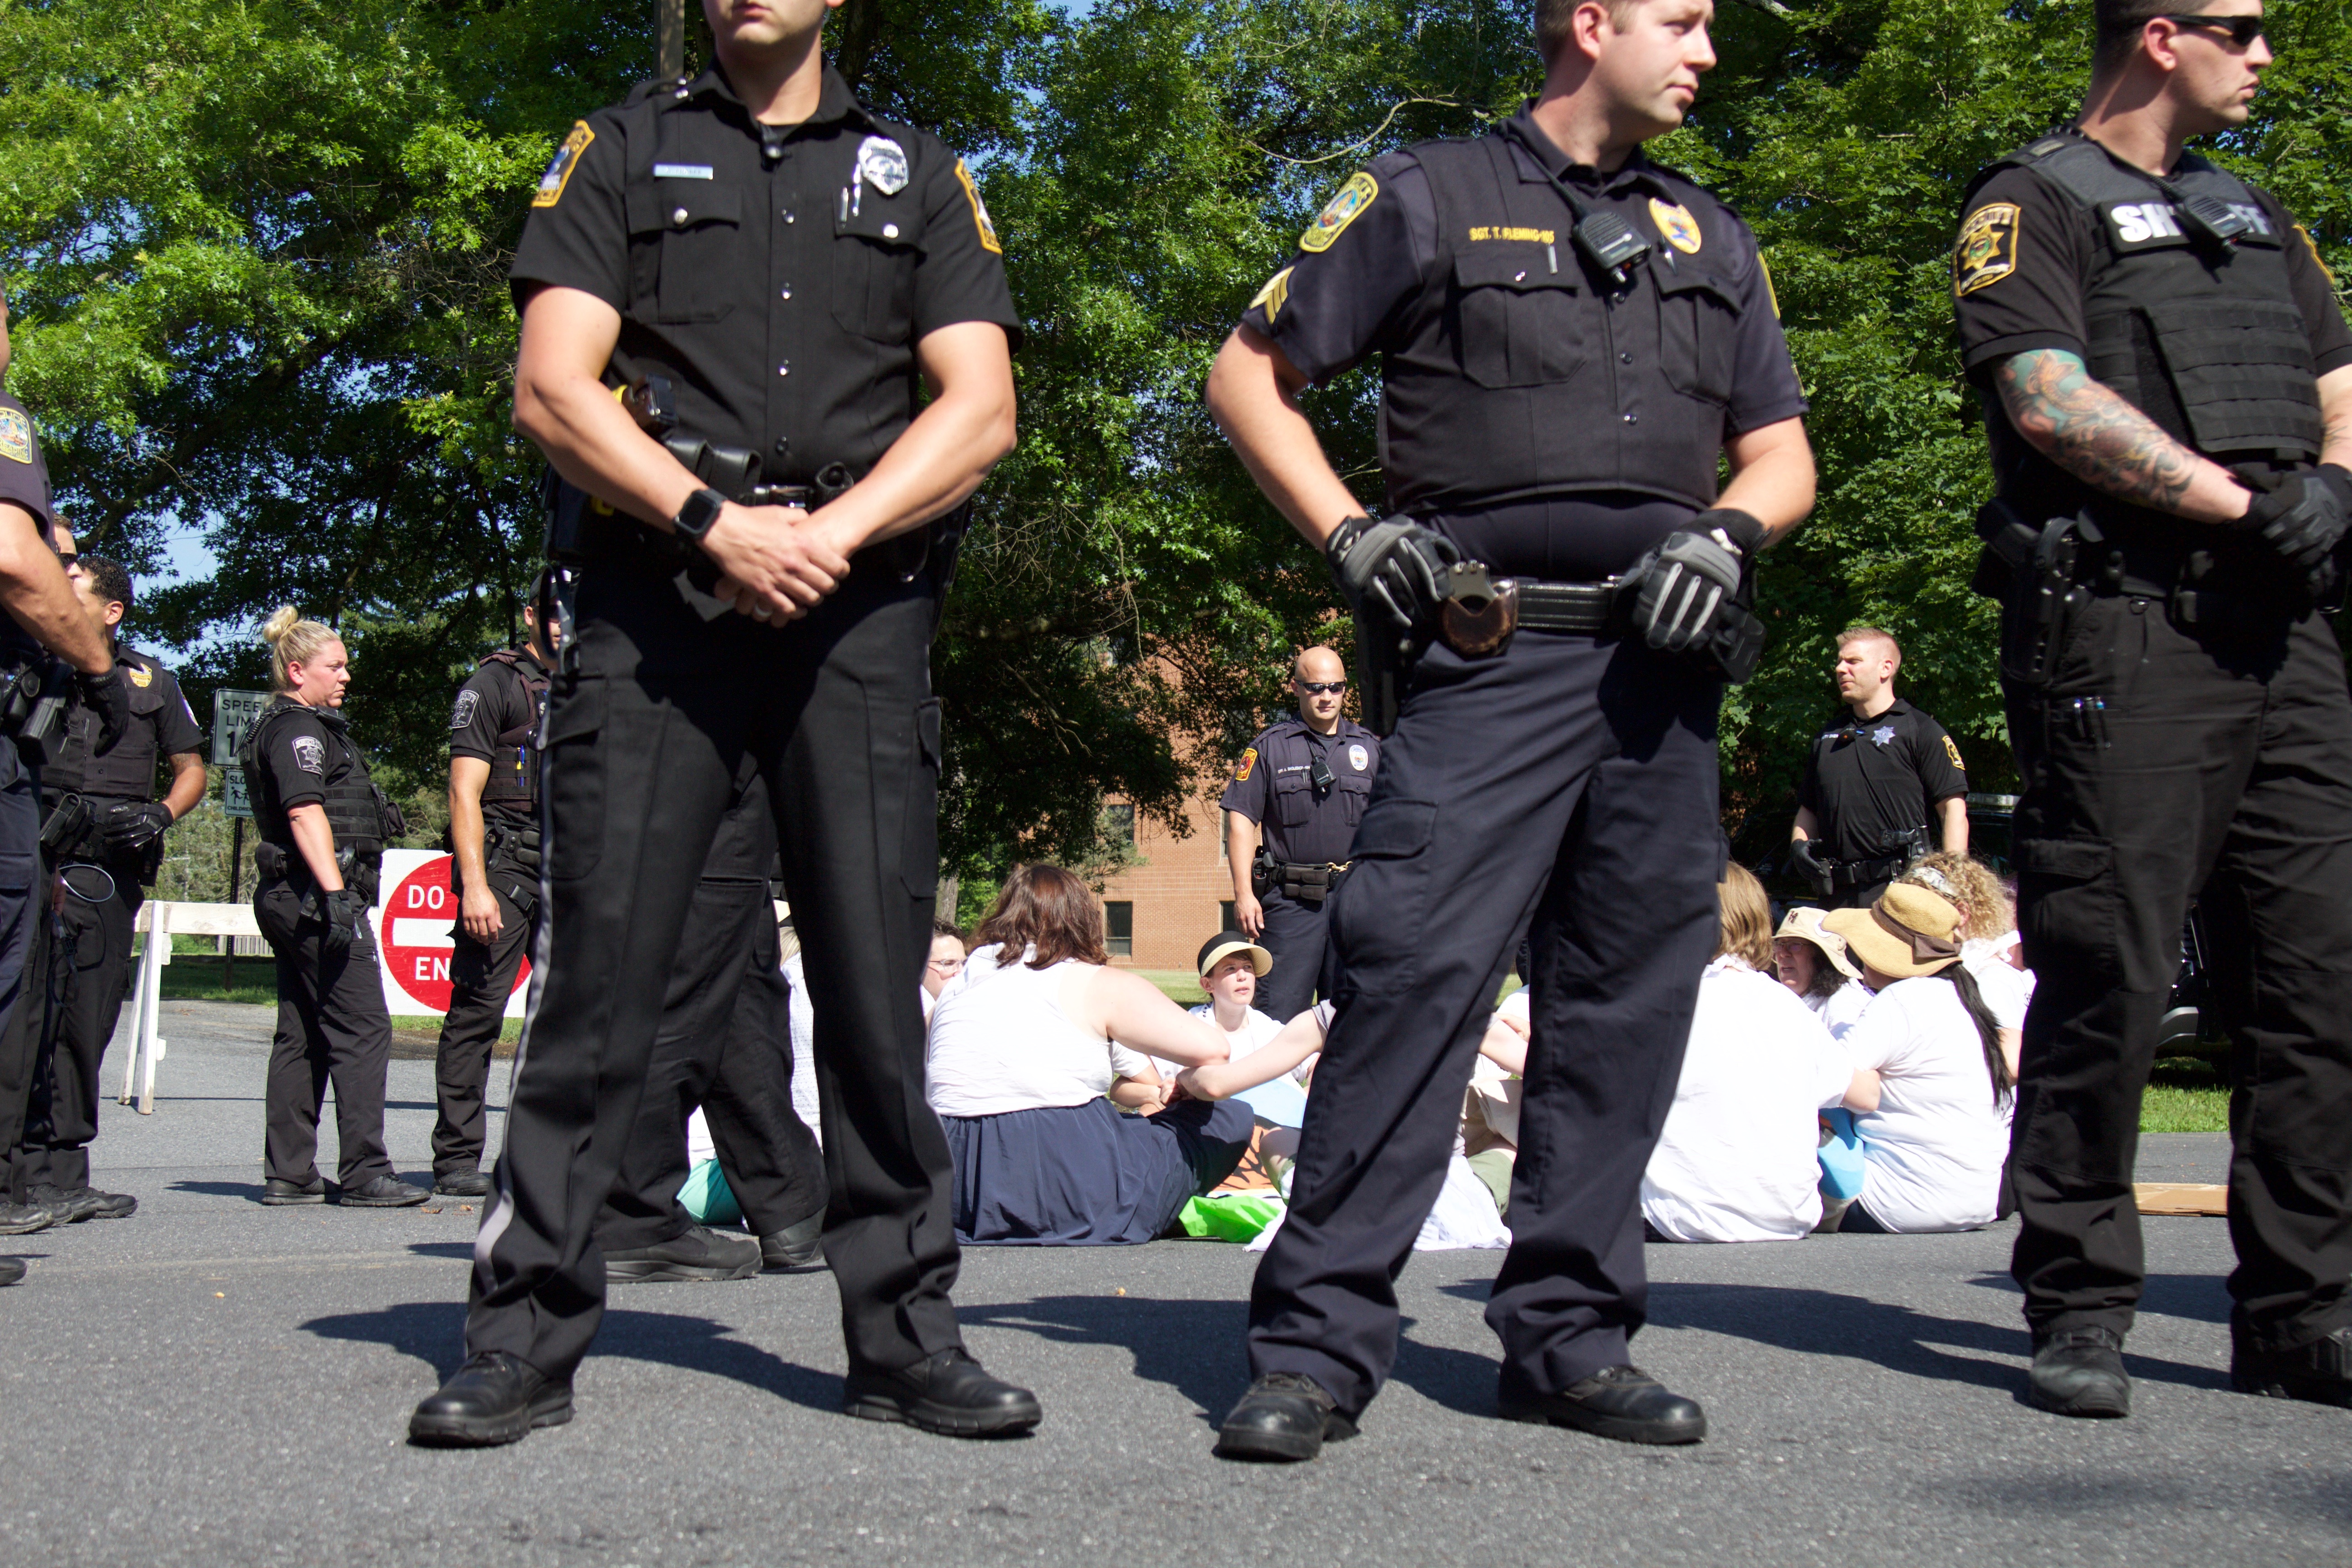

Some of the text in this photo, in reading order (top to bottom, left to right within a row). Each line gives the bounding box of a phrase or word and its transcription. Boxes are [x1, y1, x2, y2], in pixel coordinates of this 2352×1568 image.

[1469, 227, 1491, 241] SGT.
[1491, 226, 1501, 240] T.
[222, 699, 265, 712] SPEE
[230, 775, 246, 784] SLO
[408, 885, 445, 910] DO
